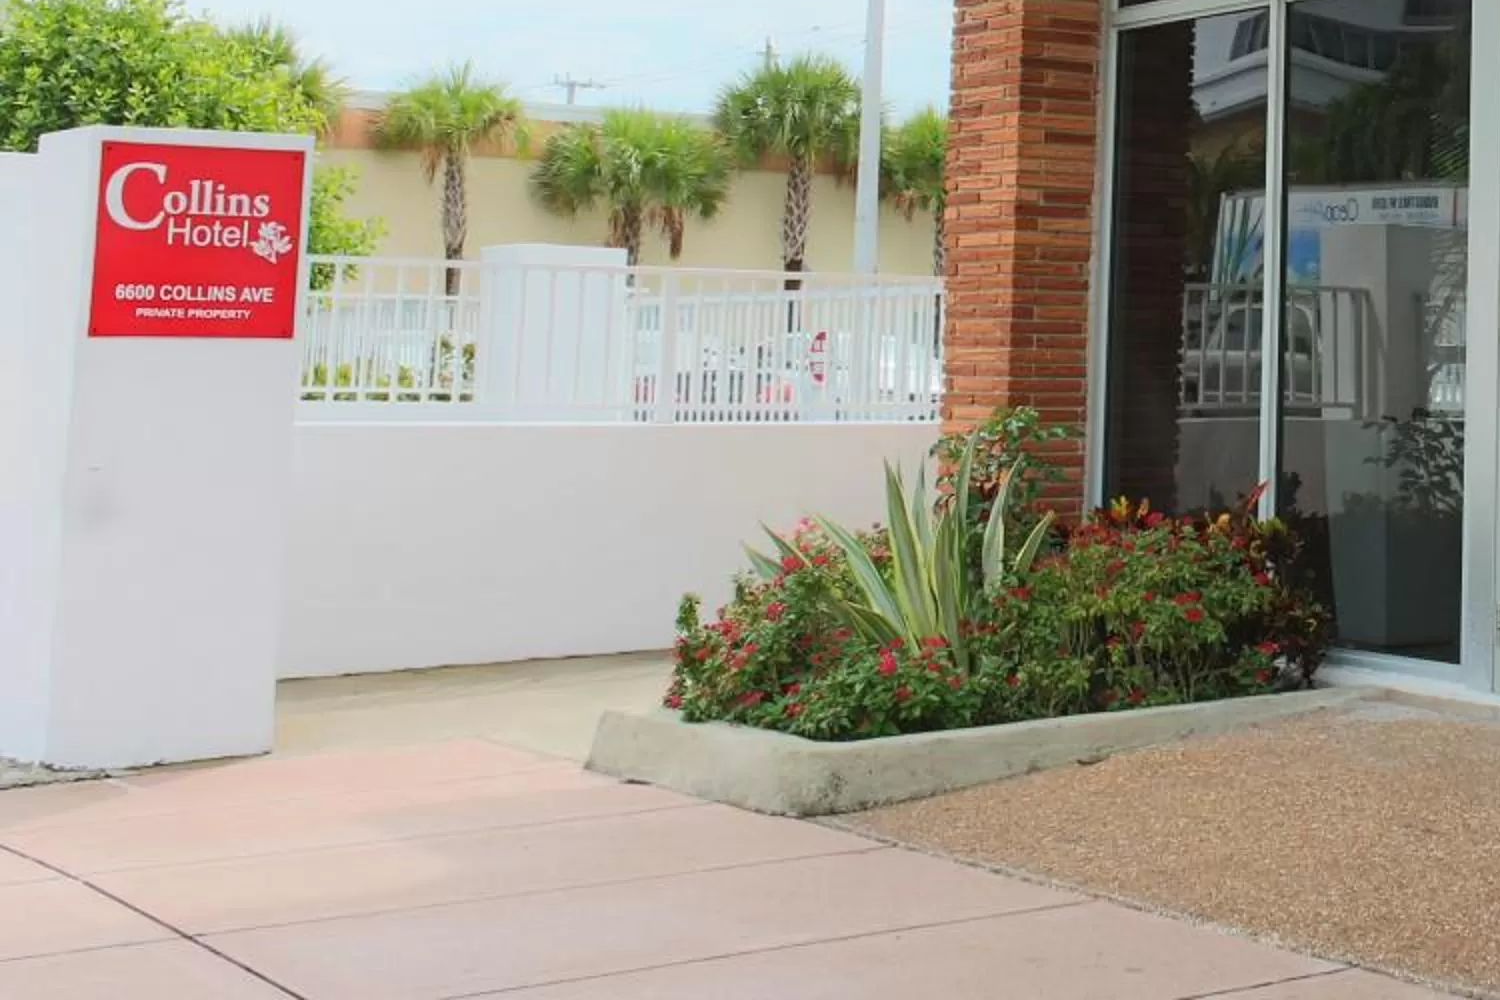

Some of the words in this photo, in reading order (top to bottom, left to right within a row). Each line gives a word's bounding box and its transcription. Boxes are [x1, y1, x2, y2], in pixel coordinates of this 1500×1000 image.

[105, 162, 270, 230] Collins
[167, 218, 250, 247] Hotel
[115, 283, 155, 300] 6600
[159, 285, 236, 301] COLLINS
[239, 287, 274, 303] AVE
[135, 307, 185, 318] PRIVATE
[187, 308, 251, 319] PROPERTY
